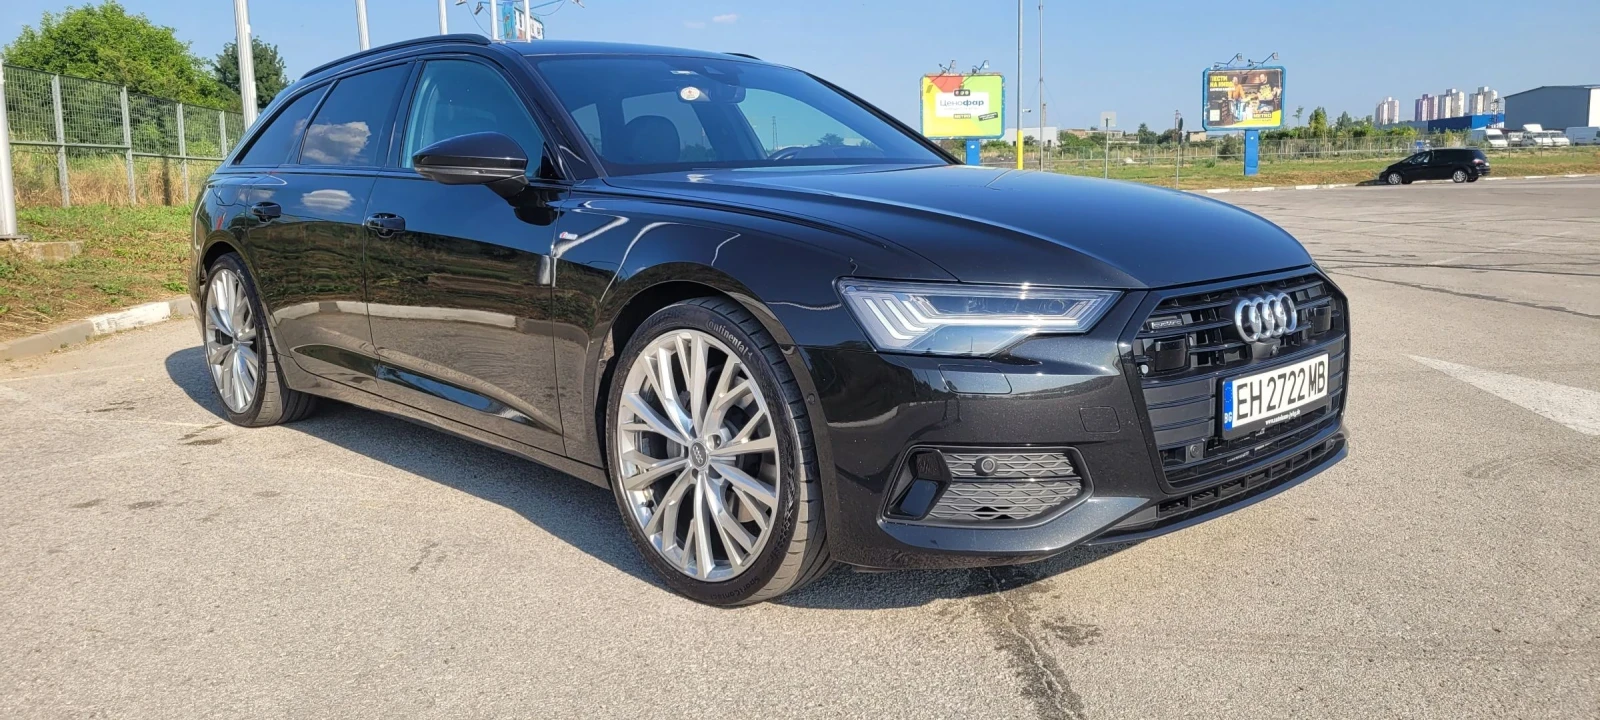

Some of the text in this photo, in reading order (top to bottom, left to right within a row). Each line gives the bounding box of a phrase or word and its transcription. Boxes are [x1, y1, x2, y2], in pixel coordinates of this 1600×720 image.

[1236, 360, 1326, 421] EH 2722 MB
[1224, 411, 1233, 424] BG
